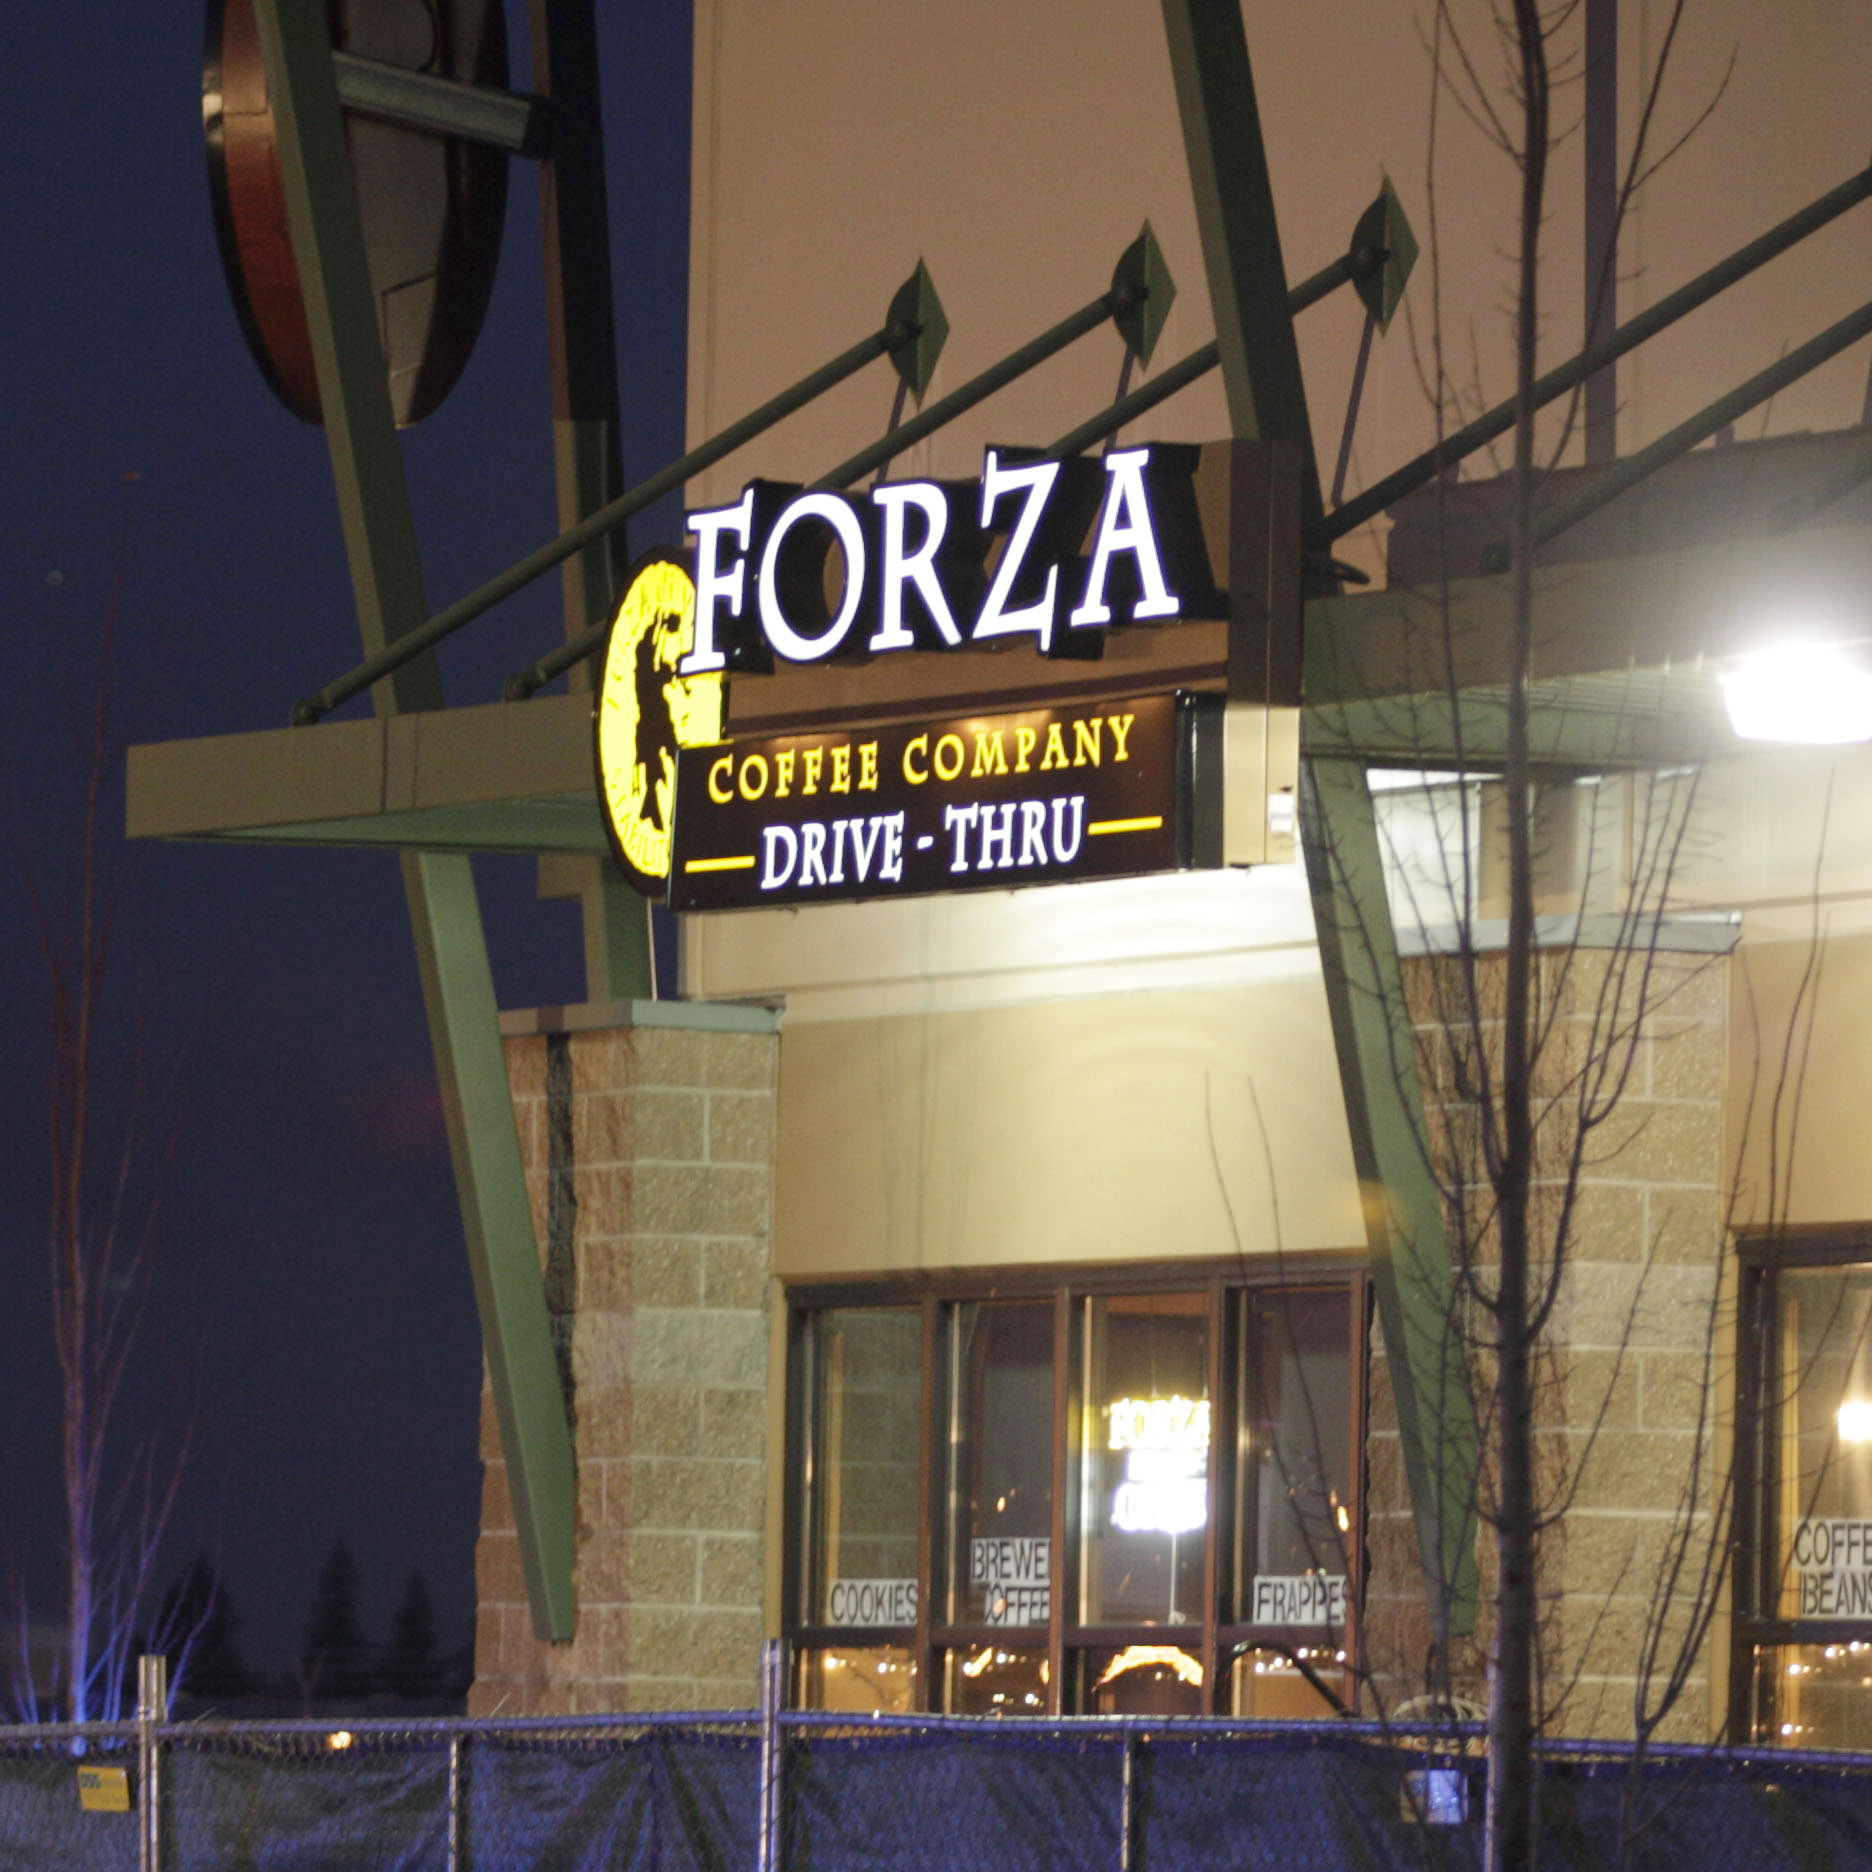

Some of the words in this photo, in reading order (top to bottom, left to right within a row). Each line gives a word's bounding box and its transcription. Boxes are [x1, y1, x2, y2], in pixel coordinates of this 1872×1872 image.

[679, 447, 1180, 676] FORZA
[707, 738, 880, 804] COFFEE
[902, 712, 1136, 784] COMPANY
[971, 1541, 1051, 1579] BREWE
[830, 1583, 918, 1622] COOKIES
